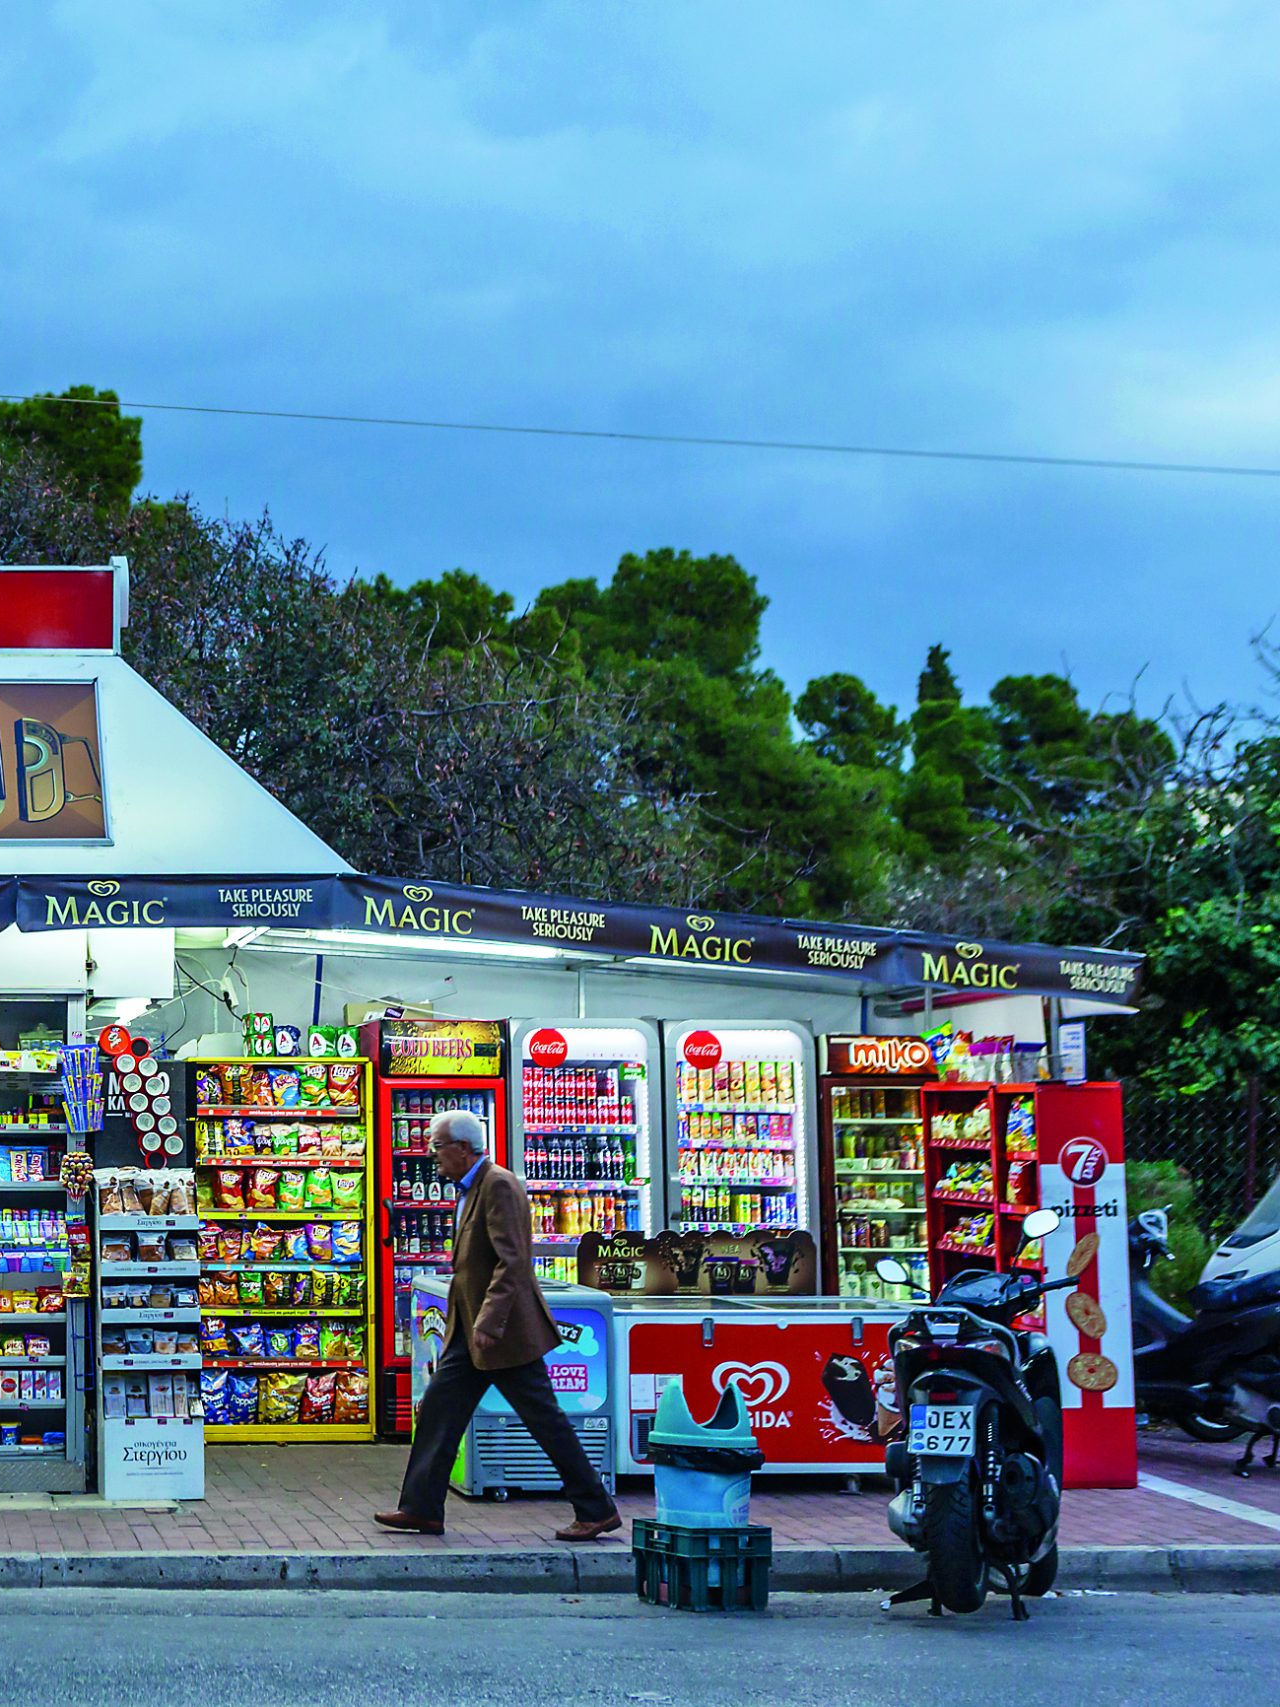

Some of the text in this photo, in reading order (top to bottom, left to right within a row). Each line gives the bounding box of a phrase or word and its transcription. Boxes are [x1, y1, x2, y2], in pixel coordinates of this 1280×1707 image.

[219, 888, 313, 903] TAKE PLEASURE
[45, 895, 164, 926] MAGIC
[232, 901, 301, 918] SERIOUSLY
[364, 895, 473, 935] MAGIC
[521, 906, 606, 929] TAKE PLEASURE
[532, 921, 595, 943] SERIOUSLY
[649, 924, 752, 964] MAGIC
[797, 934, 877, 957] TAKE PLEASURE
[808, 949, 866, 970] SERIOUSLY
[922, 952, 1018, 990] MAGIC
[391, 1038, 472, 1058] COLD BEERS
[1051, 1199, 1119, 1219] pizzeti
[598, 1244, 644, 1258] MAGIC
[553, 1367, 585, 1377] LOVE
[927, 1411, 971, 1430] OEX
[926, 1435, 971, 1452] 677
[122, 1446, 187, 1466] Στεργίου
